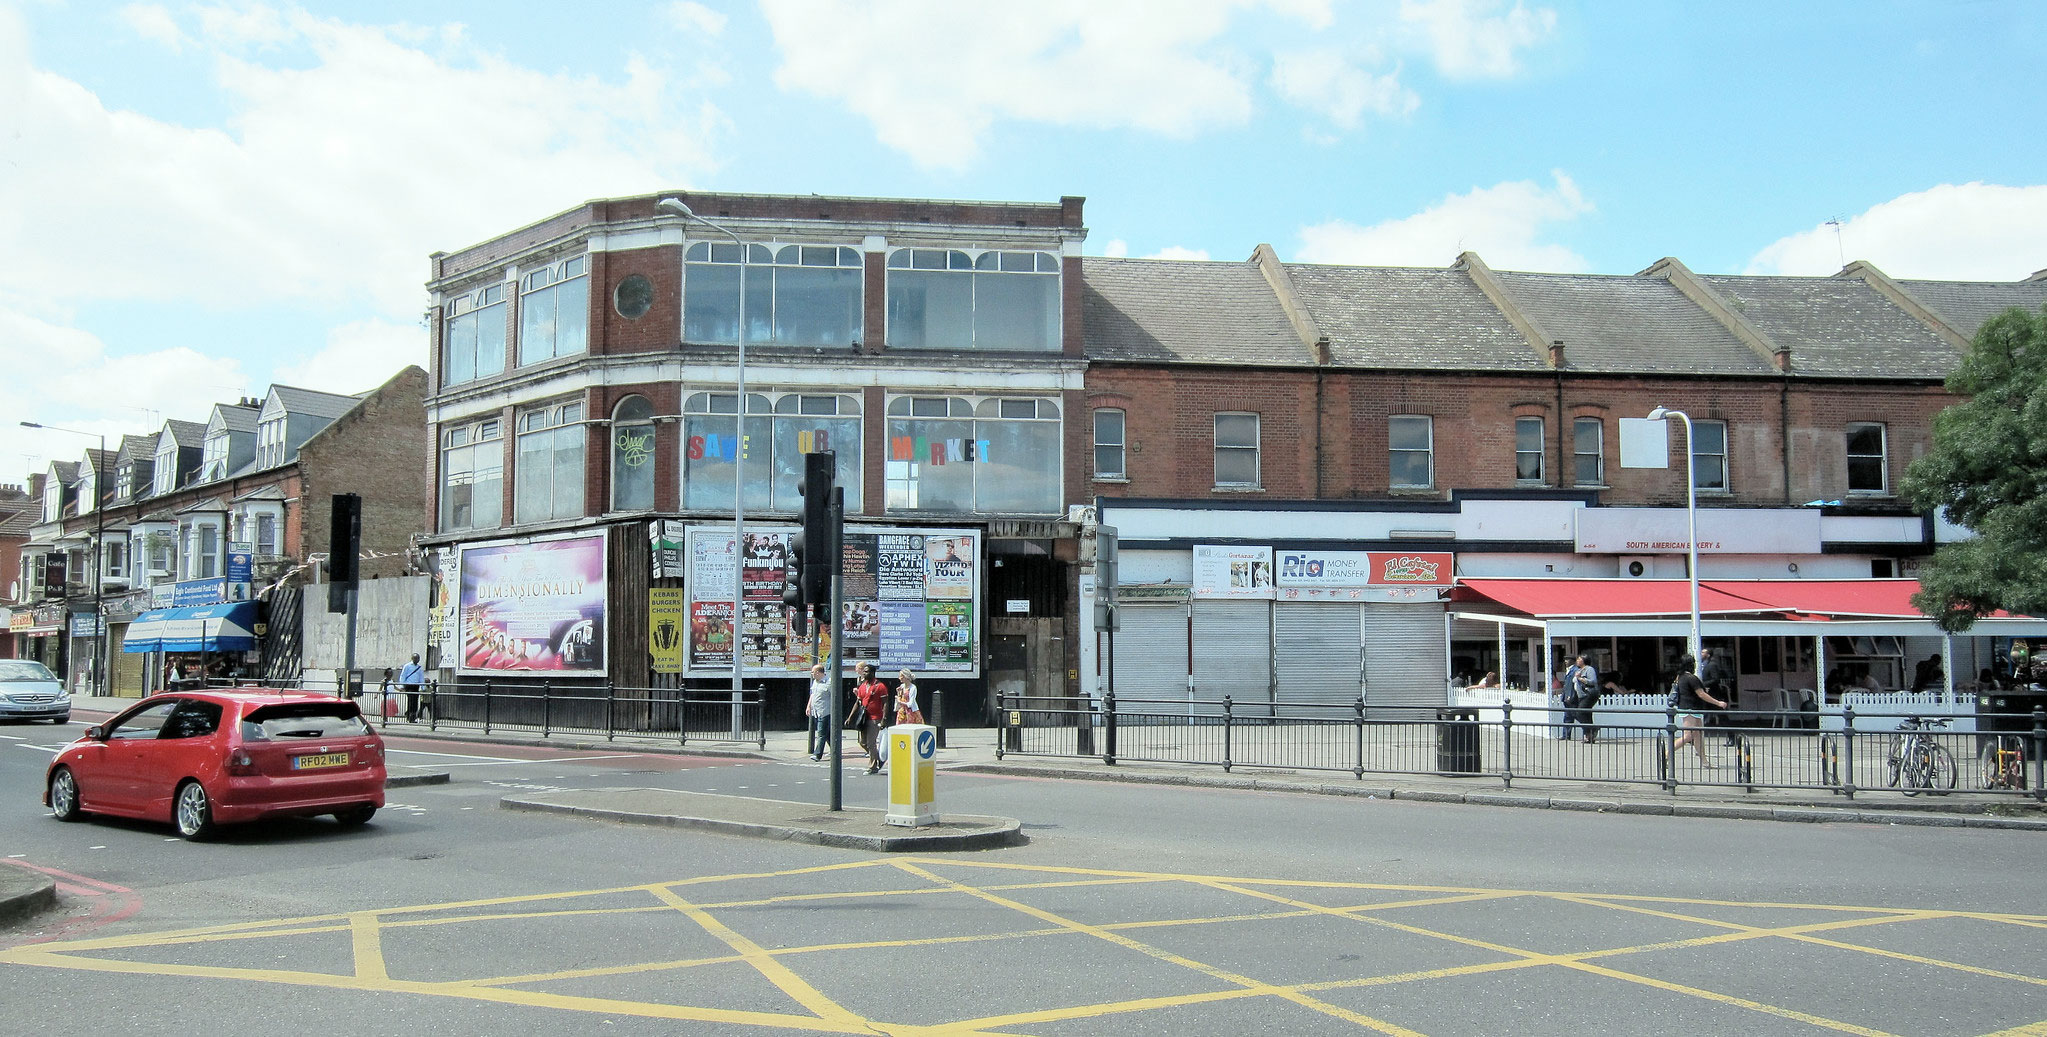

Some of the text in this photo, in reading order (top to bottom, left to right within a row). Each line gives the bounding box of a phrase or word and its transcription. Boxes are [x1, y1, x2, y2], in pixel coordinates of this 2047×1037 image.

[892, 436, 990, 466] MARKET
[879, 535, 910, 545] BANGFACE
[1626, 541, 1649, 549] SOUTH
[1651, 541, 1686, 549] AMERICAN
[1715, 541, 1721, 549] &
[1282, 554, 1358, 578] Ria MONEY
[935, 569, 965, 577] TOUR
[1327, 570, 1365, 578] TRANSFER
[479, 580, 585, 598] DIMENSIONALLY
[301, 753, 347, 767] RF02 MWE
